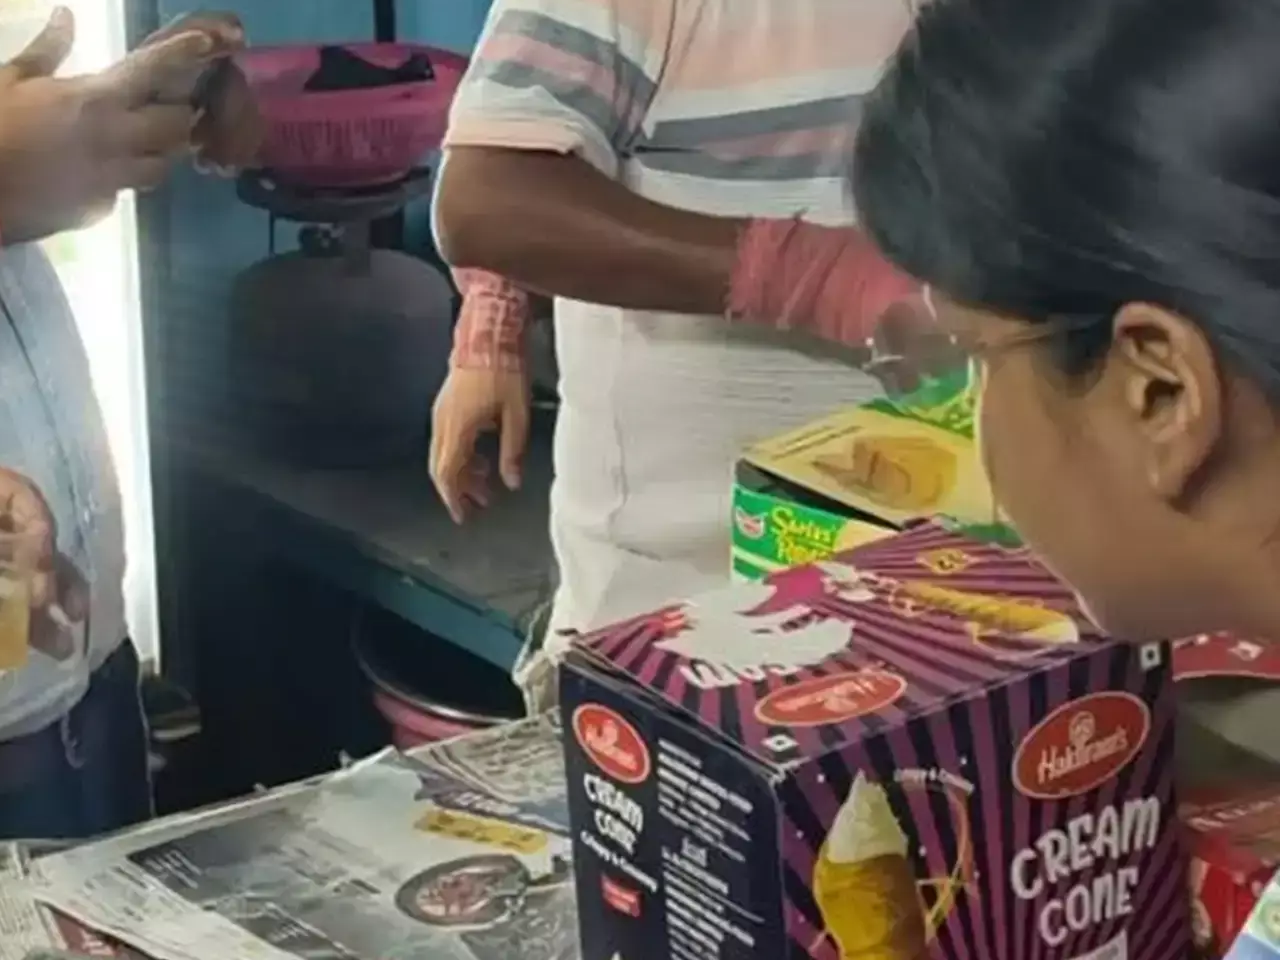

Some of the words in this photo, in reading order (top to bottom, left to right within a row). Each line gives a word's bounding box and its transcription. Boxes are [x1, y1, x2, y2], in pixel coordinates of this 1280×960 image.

[583, 773, 644, 833] CREAM
[1010, 795, 1161, 900] CREAM
[1038, 865, 1139, 947] CONE
